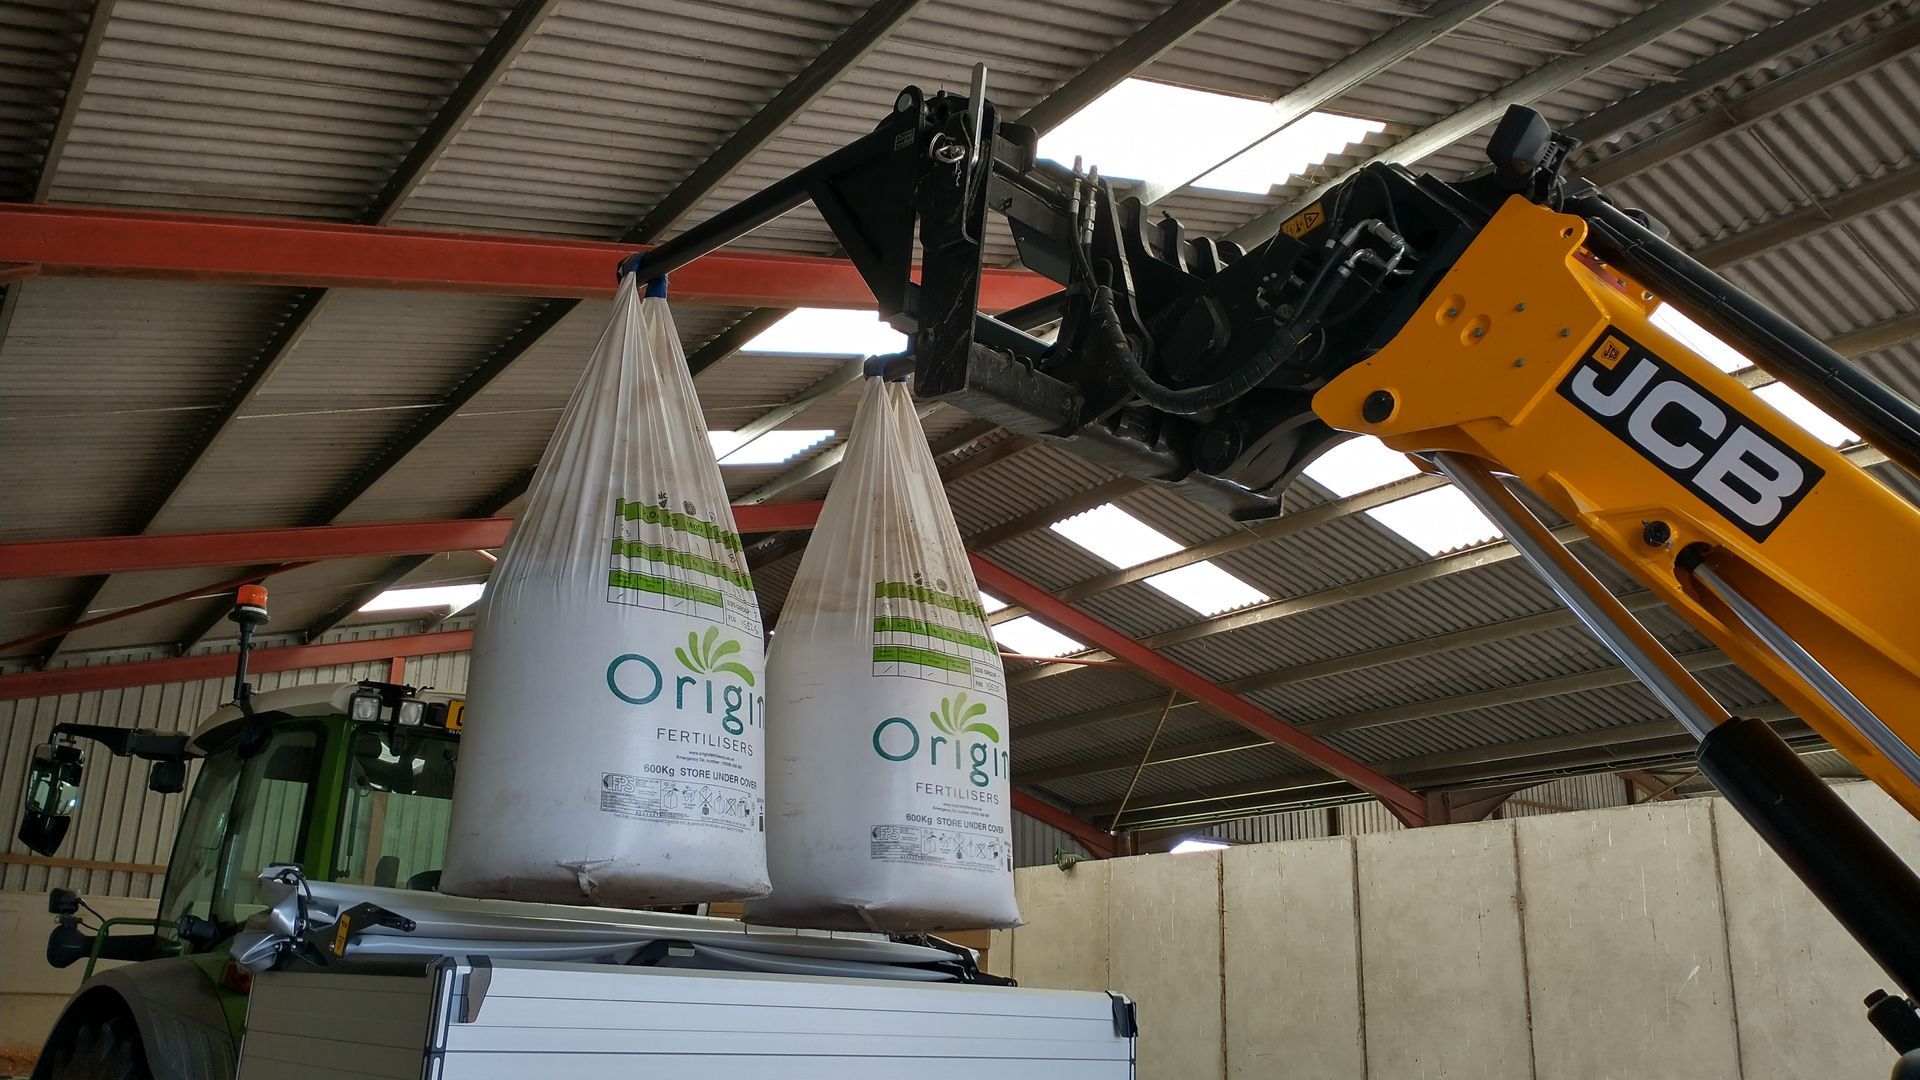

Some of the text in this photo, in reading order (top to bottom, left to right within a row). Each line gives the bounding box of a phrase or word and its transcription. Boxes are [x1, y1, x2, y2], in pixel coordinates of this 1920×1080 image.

[1571, 357, 1804, 526] JCB
[657, 728, 753, 756] FERTILISERS
[612, 775, 635, 793] FPS
[643, 763, 675, 777] 600Kg
[680, 767, 711, 779] STORE
[712, 771, 739, 784] UNDER
[916, 782, 999, 805] FERTILISERS
[906, 813, 933, 826] 600Kg
[936, 816, 962, 828] STORE
[964, 820, 987, 832] UNDER
